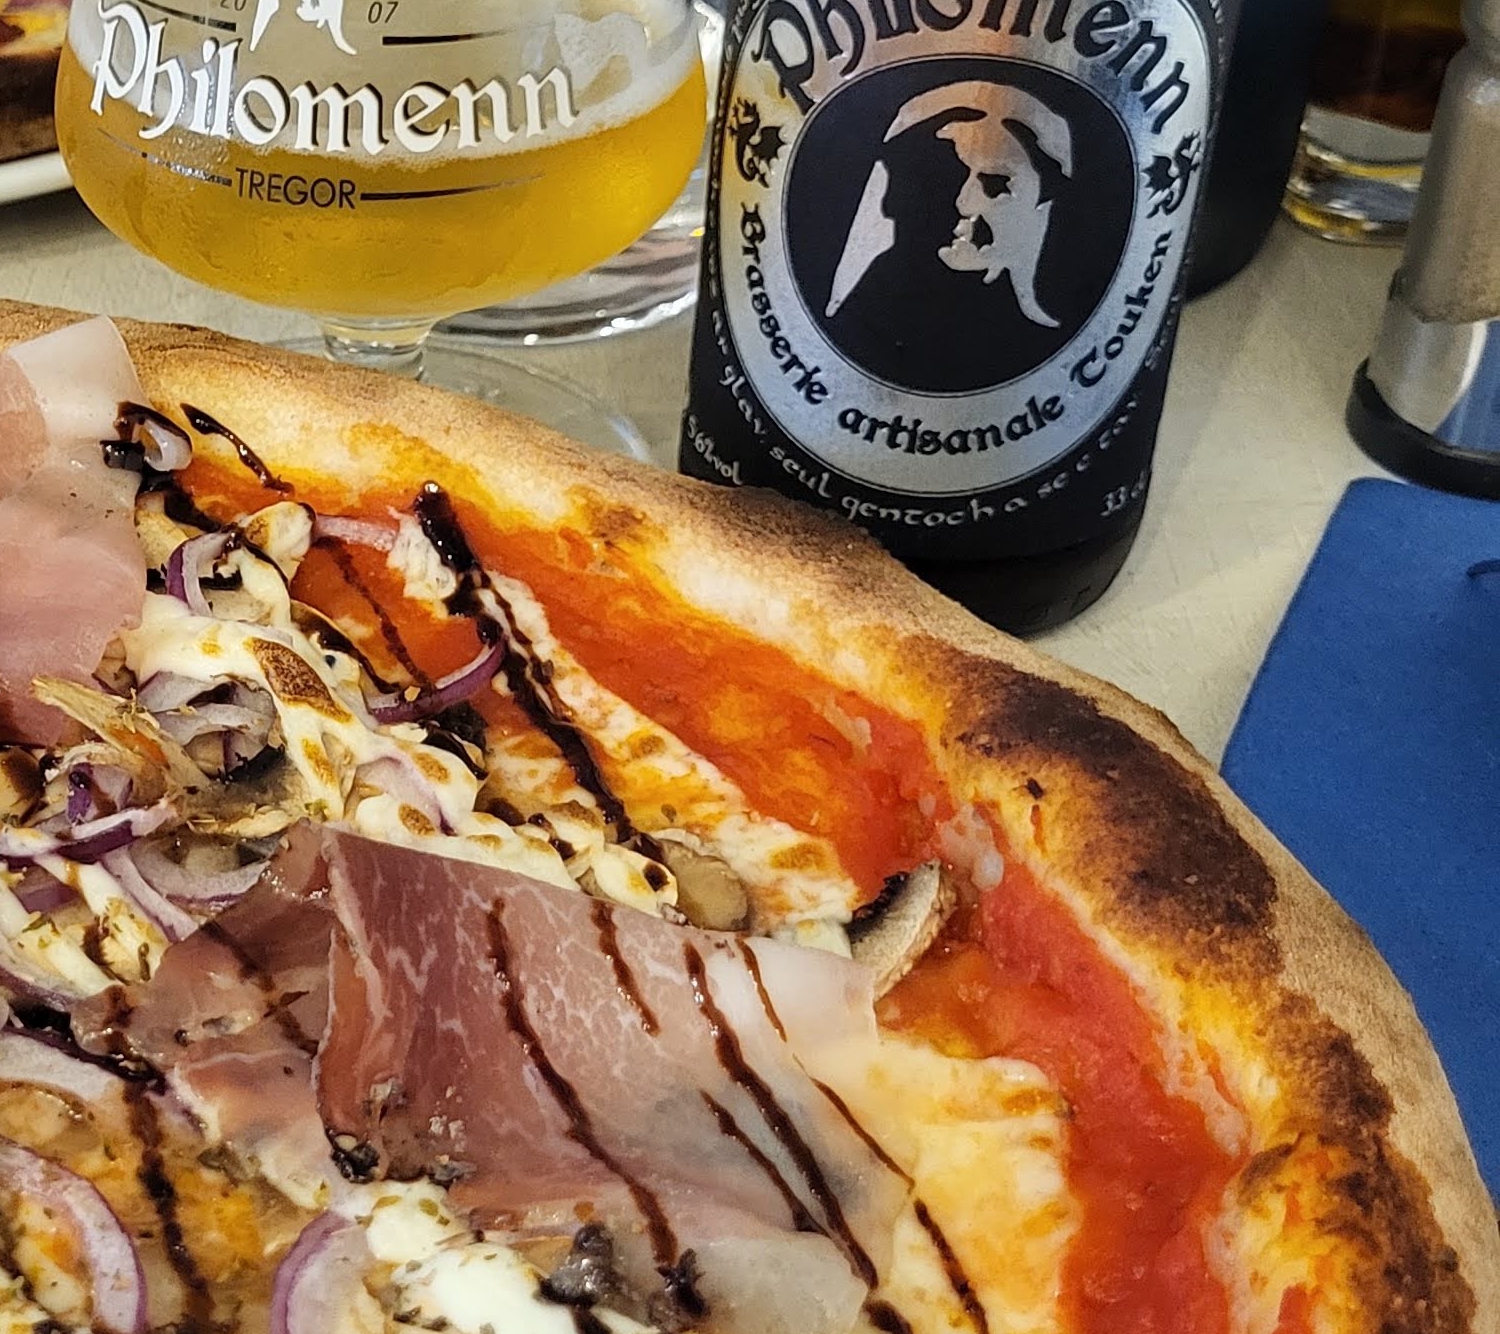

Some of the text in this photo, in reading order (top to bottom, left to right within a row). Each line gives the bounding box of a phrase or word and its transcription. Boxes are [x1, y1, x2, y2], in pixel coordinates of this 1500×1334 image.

[367, 0, 400, 25] 07
[235, 168, 357, 210] TREGOR
[740, 201, 829, 406] Brasserie
[837, 395, 1065, 455] artisanale
[1069, 229, 1173, 389] Touken
[769, 446, 833, 498] seul
[1003, 496, 1029, 513] a
